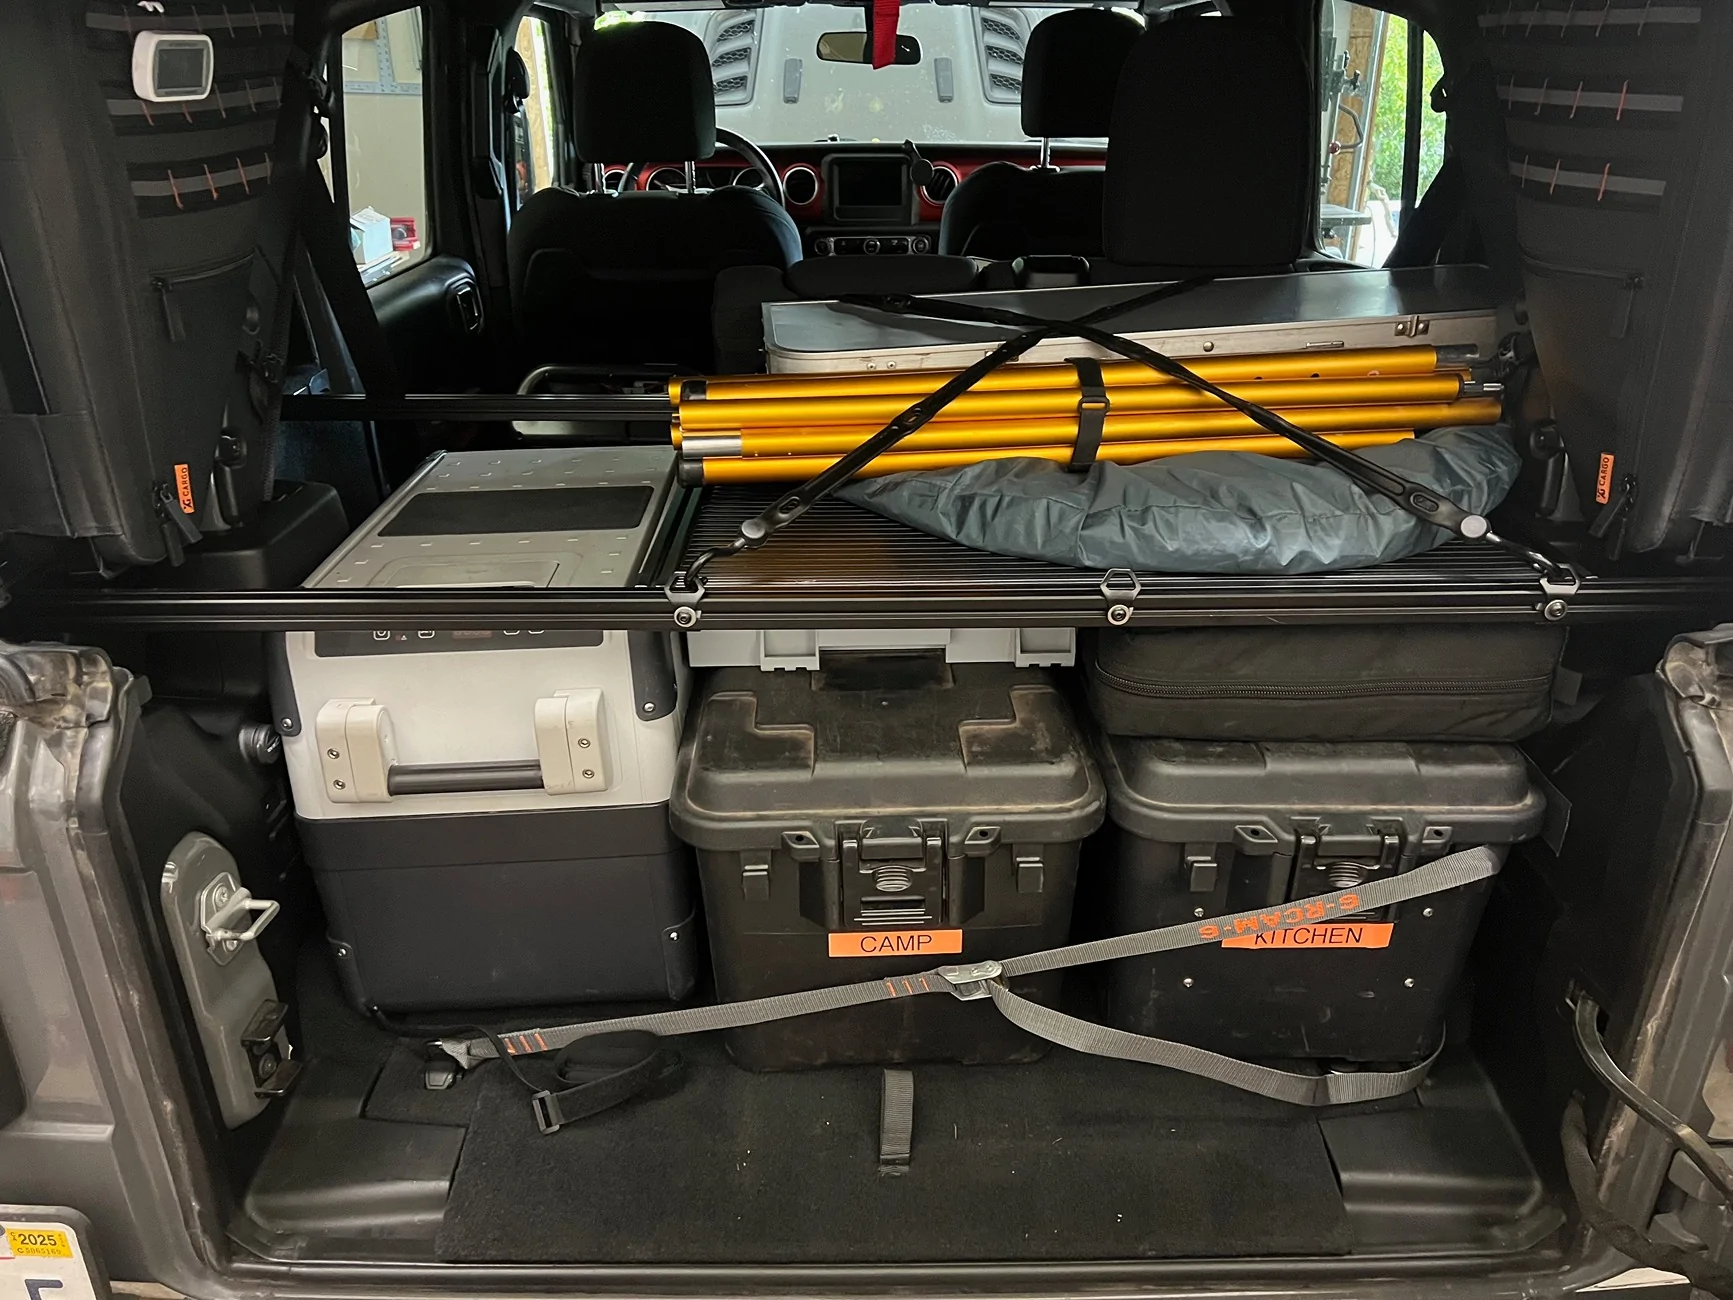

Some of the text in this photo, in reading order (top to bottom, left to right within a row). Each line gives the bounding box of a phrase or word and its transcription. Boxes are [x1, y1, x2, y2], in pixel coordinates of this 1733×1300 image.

[1598, 457, 1610, 486] CARGO
[181, 467, 190, 497] CARGO
[860, 934, 932, 953] CAMP
[1254, 927, 1364, 945] KITCHEN
[17, 1233, 57, 1247] 2025
